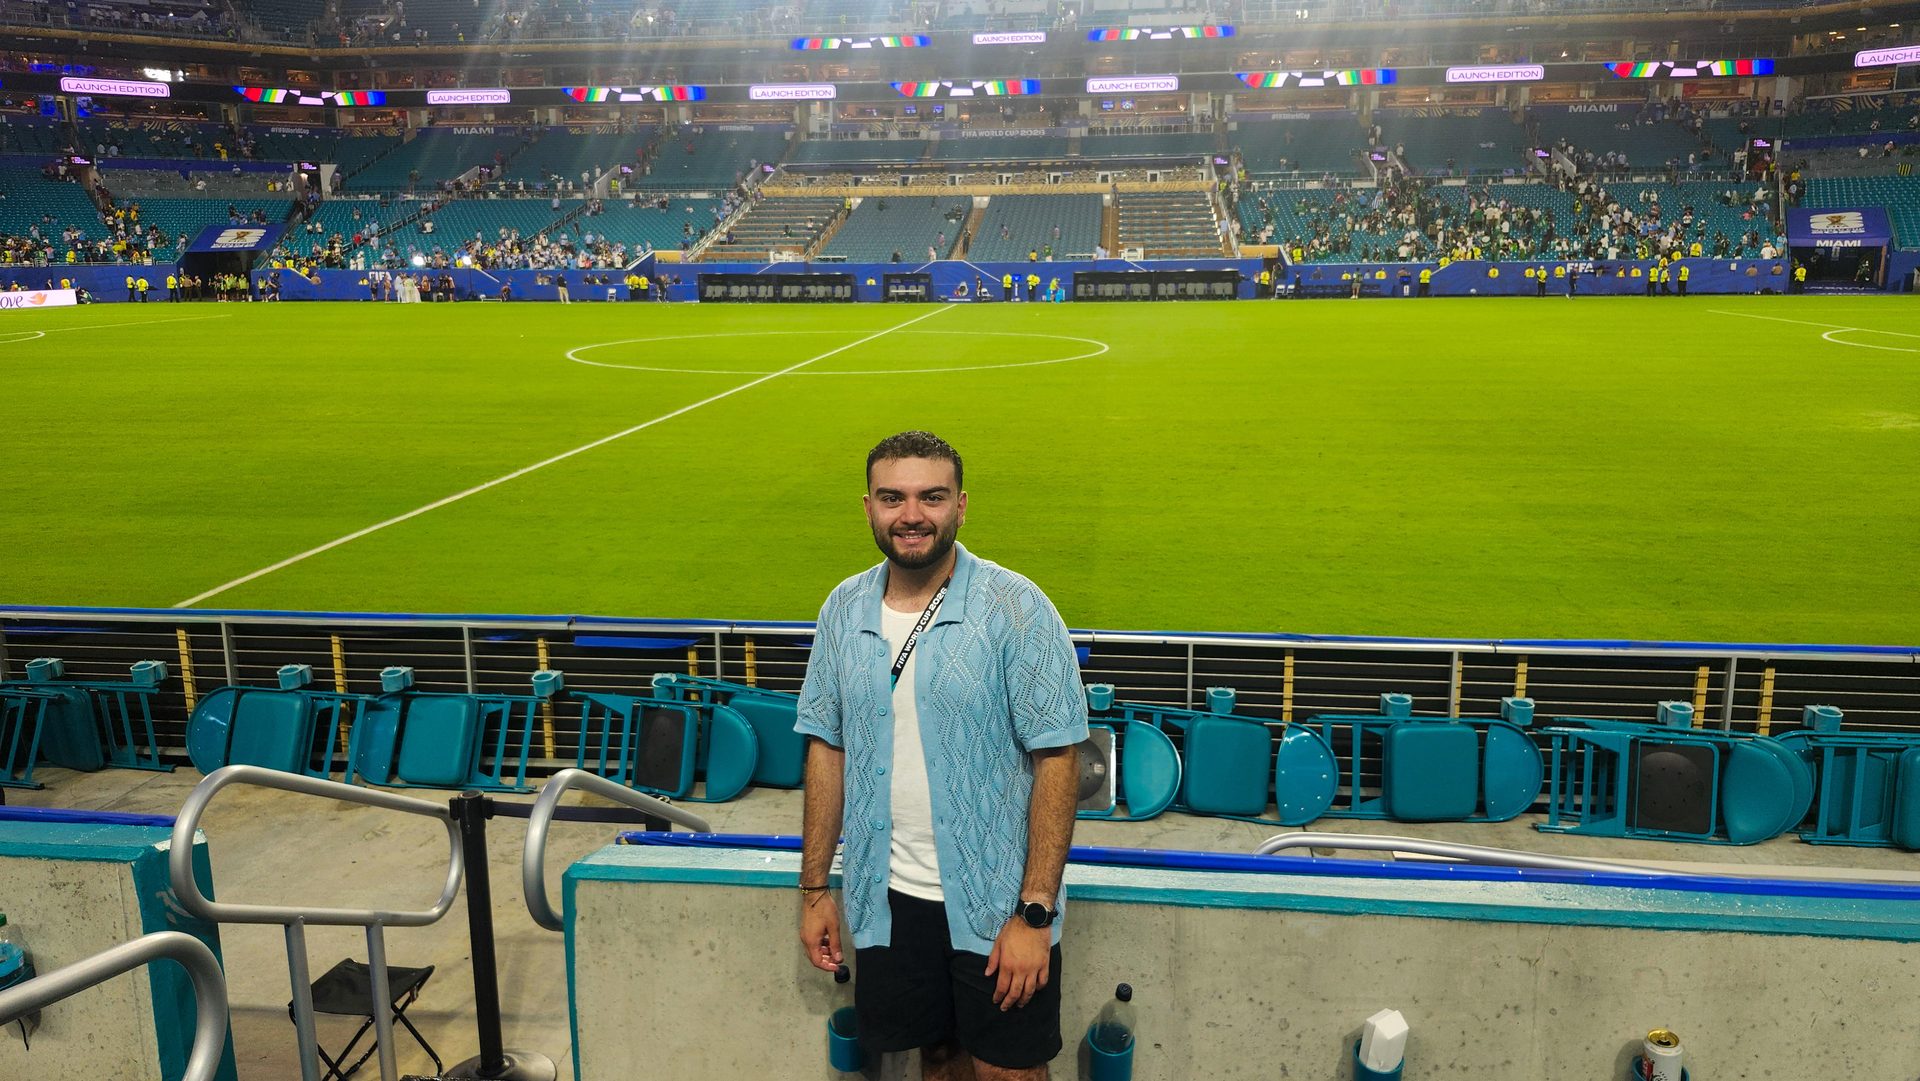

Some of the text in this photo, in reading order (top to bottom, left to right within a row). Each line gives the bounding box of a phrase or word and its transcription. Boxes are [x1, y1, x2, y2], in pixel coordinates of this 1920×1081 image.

[977, 34, 1042, 43] LAUNCH EDITION
[1861, 52, 1913, 64] LAUNCH
[1451, 70, 1539, 79] LAUNCH EDITION
[67, 82, 165, 95] LAUNCH EDITION
[1092, 81, 1174, 91] LAUNCH EDITION
[432, 94, 506, 102] LAUNCH EDITION
[754, 89, 832, 98] LAUNCH EDITION
[1568, 104, 1618, 113] MIAMI
[453, 127, 495, 135] MIAMI
[1815, 239, 1861, 247] MIAMI
[1566, 262, 1595, 273] FIFA
[896, 586, 948, 669] FIFA WORLD CUP 2026
